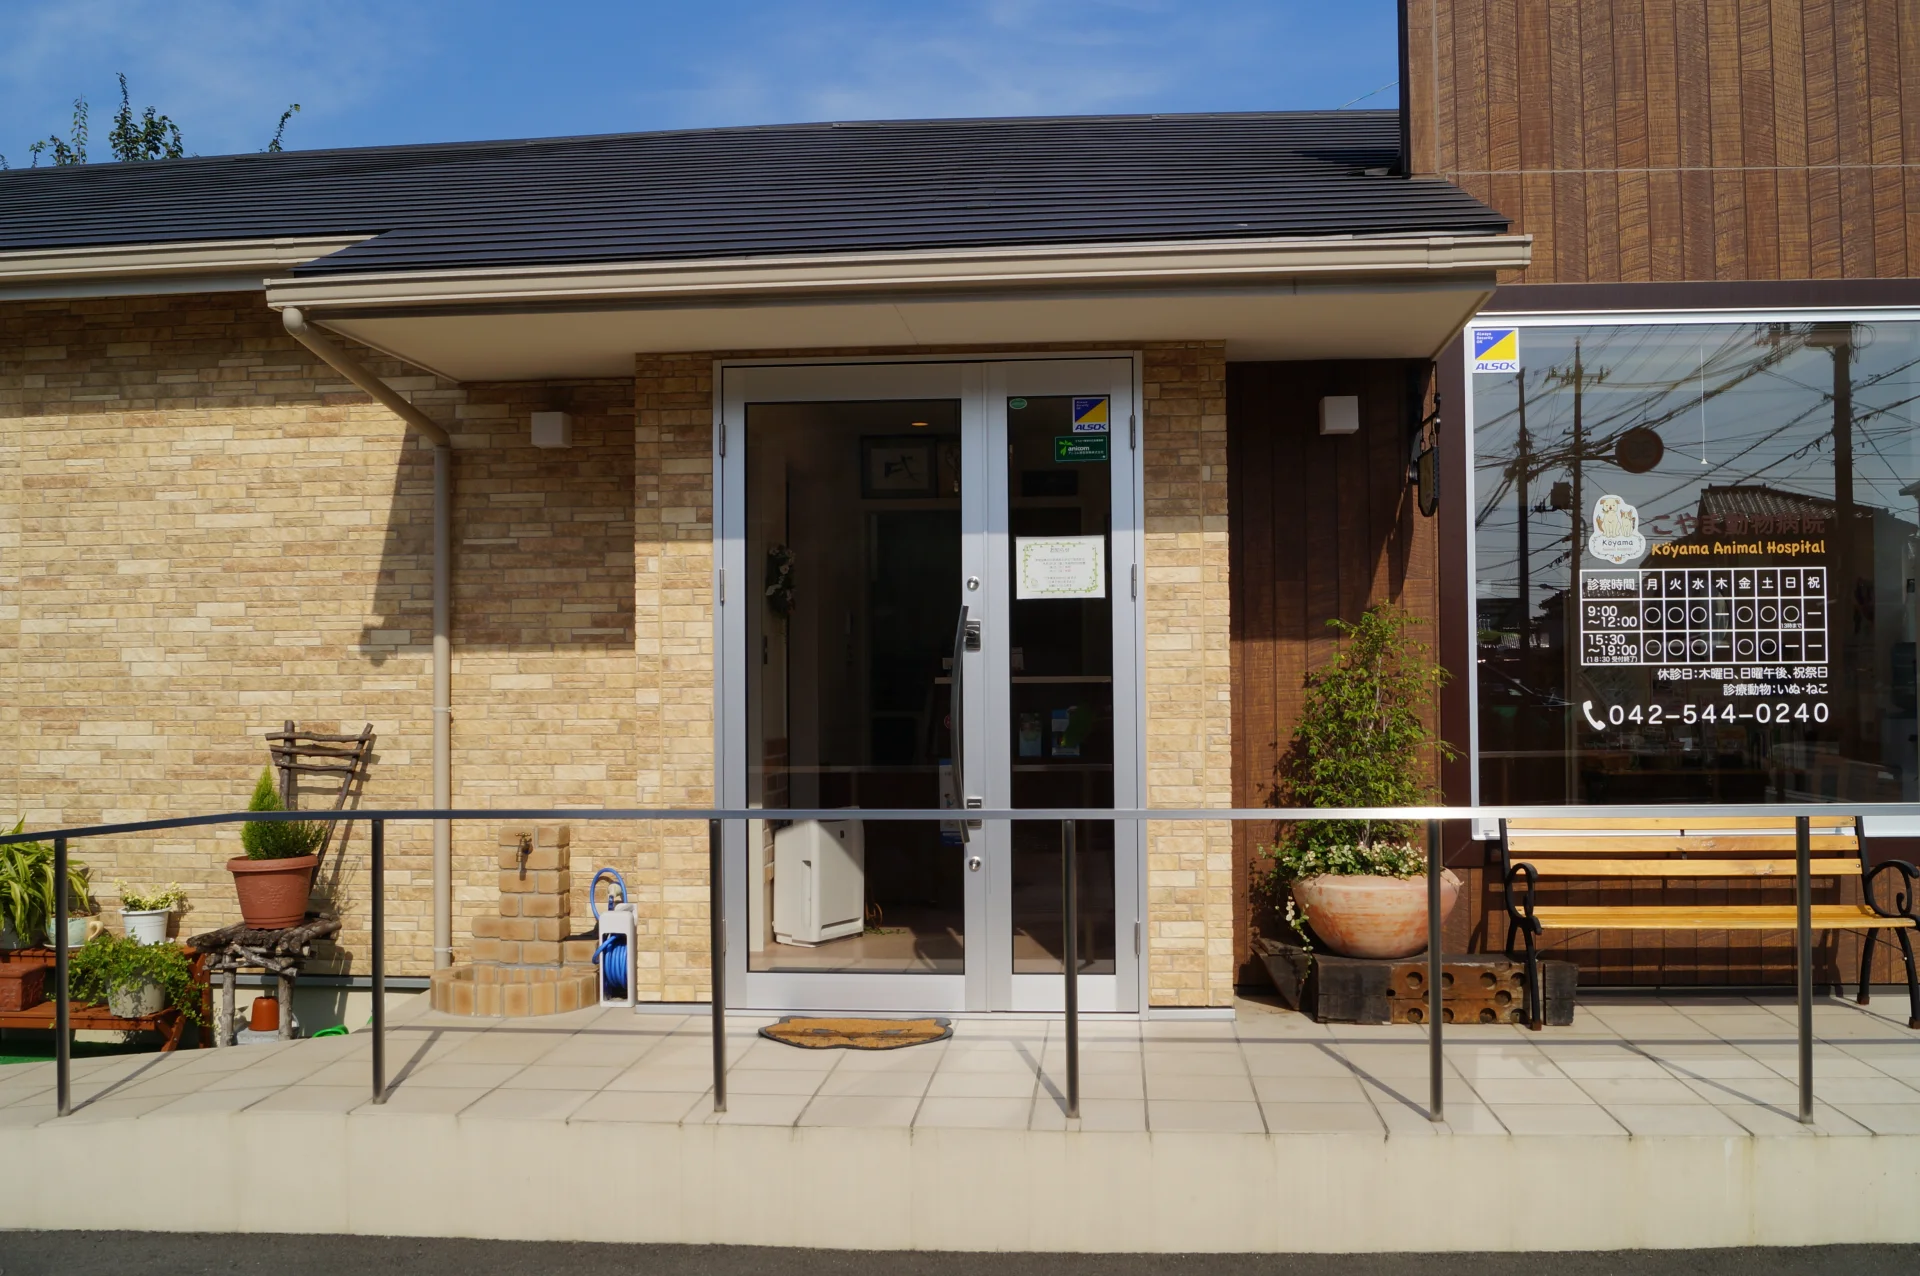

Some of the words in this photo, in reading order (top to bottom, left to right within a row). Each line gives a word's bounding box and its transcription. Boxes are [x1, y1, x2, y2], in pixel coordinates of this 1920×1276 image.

[1476, 362, 1516, 370] ALSOK
[1652, 512, 1825, 535] こやま動物病院
[1713, 540, 1763, 554] Animal
[1766, 539, 1825, 556] Hospital
[1587, 578, 1635, 591] 診察時間
[1646, 578, 1658, 590] 月
[1669, 578, 1682, 590] 火
[1691, 578, 1705, 590] 水
[1715, 577, 1728, 589] 木
[1738, 577, 1751, 589] 金
[1761, 577, 1774, 588] 土
[1785, 577, 1796, 588] 日
[1807, 576, 1820, 588] 祝
[1587, 605, 1618, 617] 9:00
[1588, 634, 1626, 646] 15:30
[1609, 702, 1829, 725] 042-544-0240
